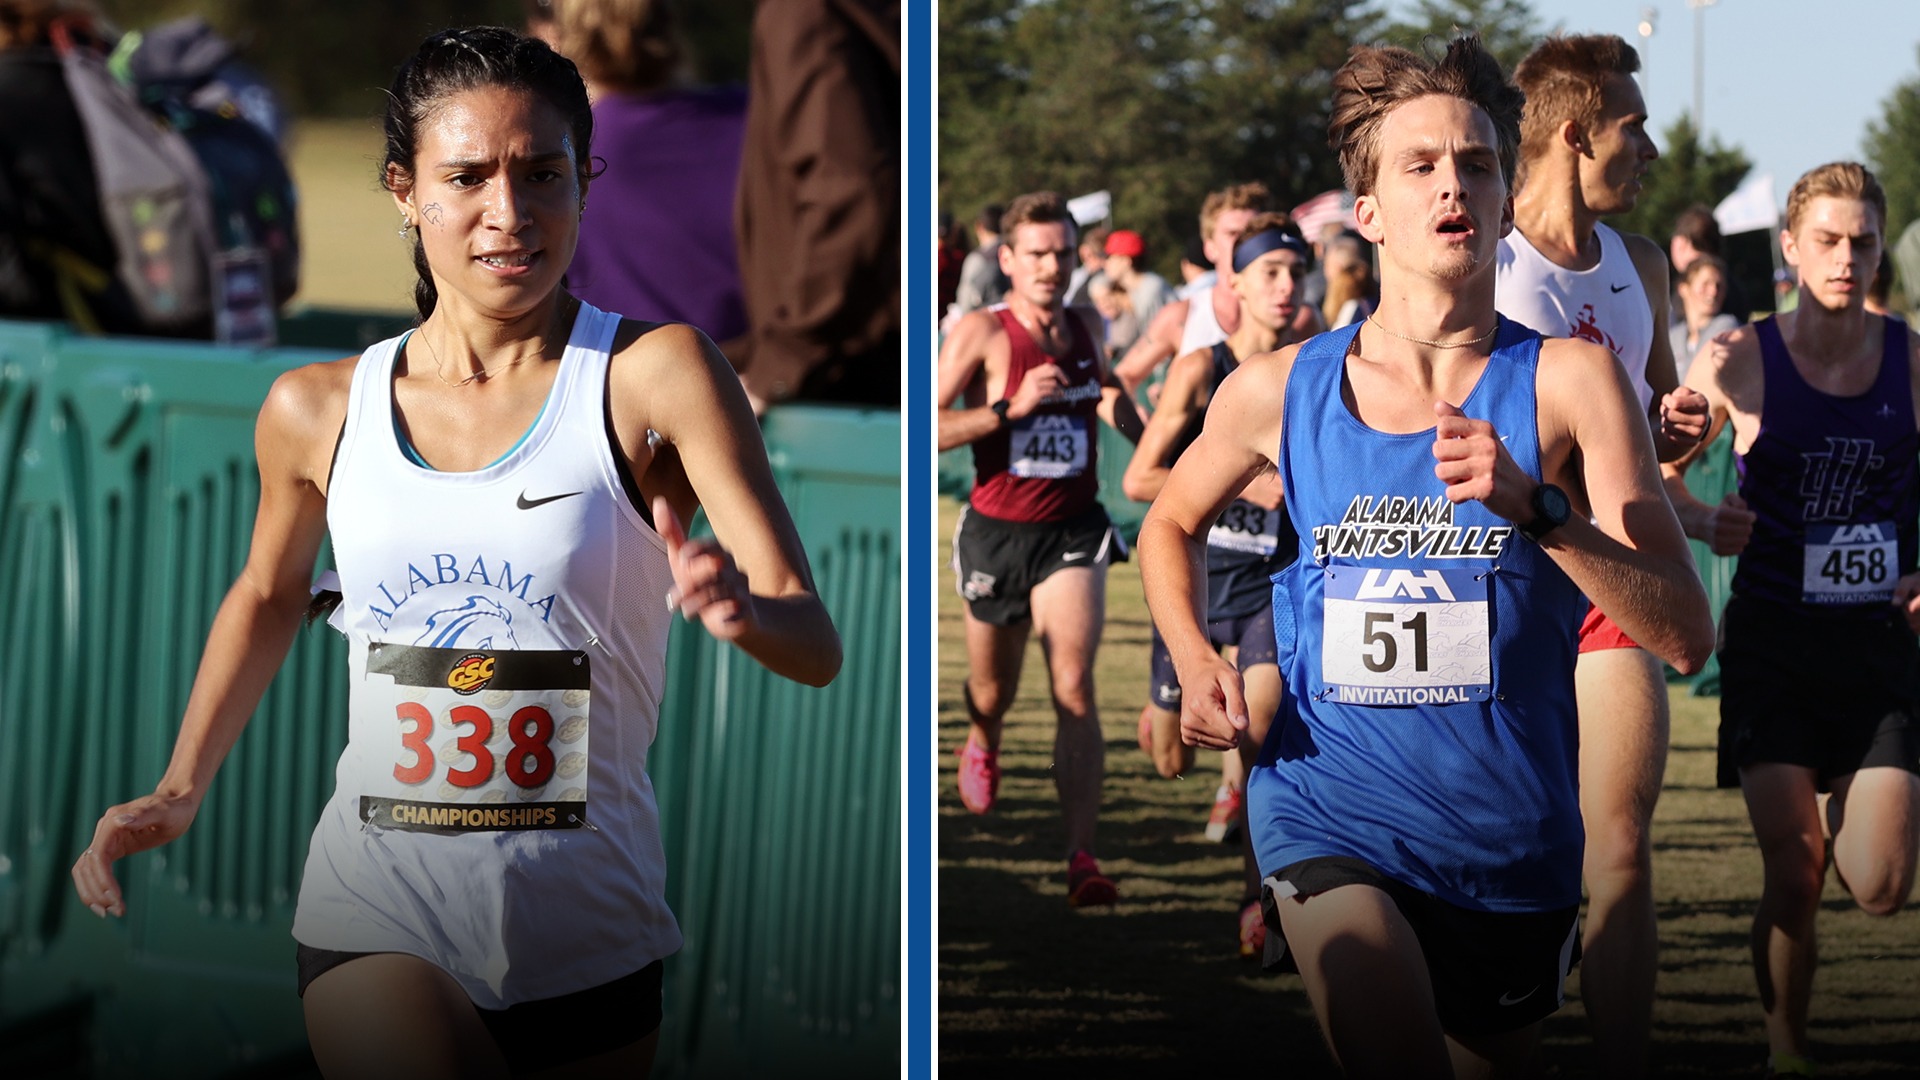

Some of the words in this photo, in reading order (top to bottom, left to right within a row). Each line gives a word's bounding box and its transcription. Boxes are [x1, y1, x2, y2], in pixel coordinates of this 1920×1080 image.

[1024, 434, 1075, 462] 443
[1341, 495, 1454, 528] ALABAMA
[1312, 525, 1512, 560] HUNTSVILLE
[1821, 547, 1887, 585] 458
[369, 553, 556, 633] ALABAMA
[1355, 568, 1457, 601] UAH
[1362, 611, 1429, 673] 51
[448, 657, 496, 688] GSC
[1339, 685, 1470, 704] INVITATIONAL
[393, 702, 555, 788] 338
[391, 804, 557, 827] CHAMPIONSHIPS
